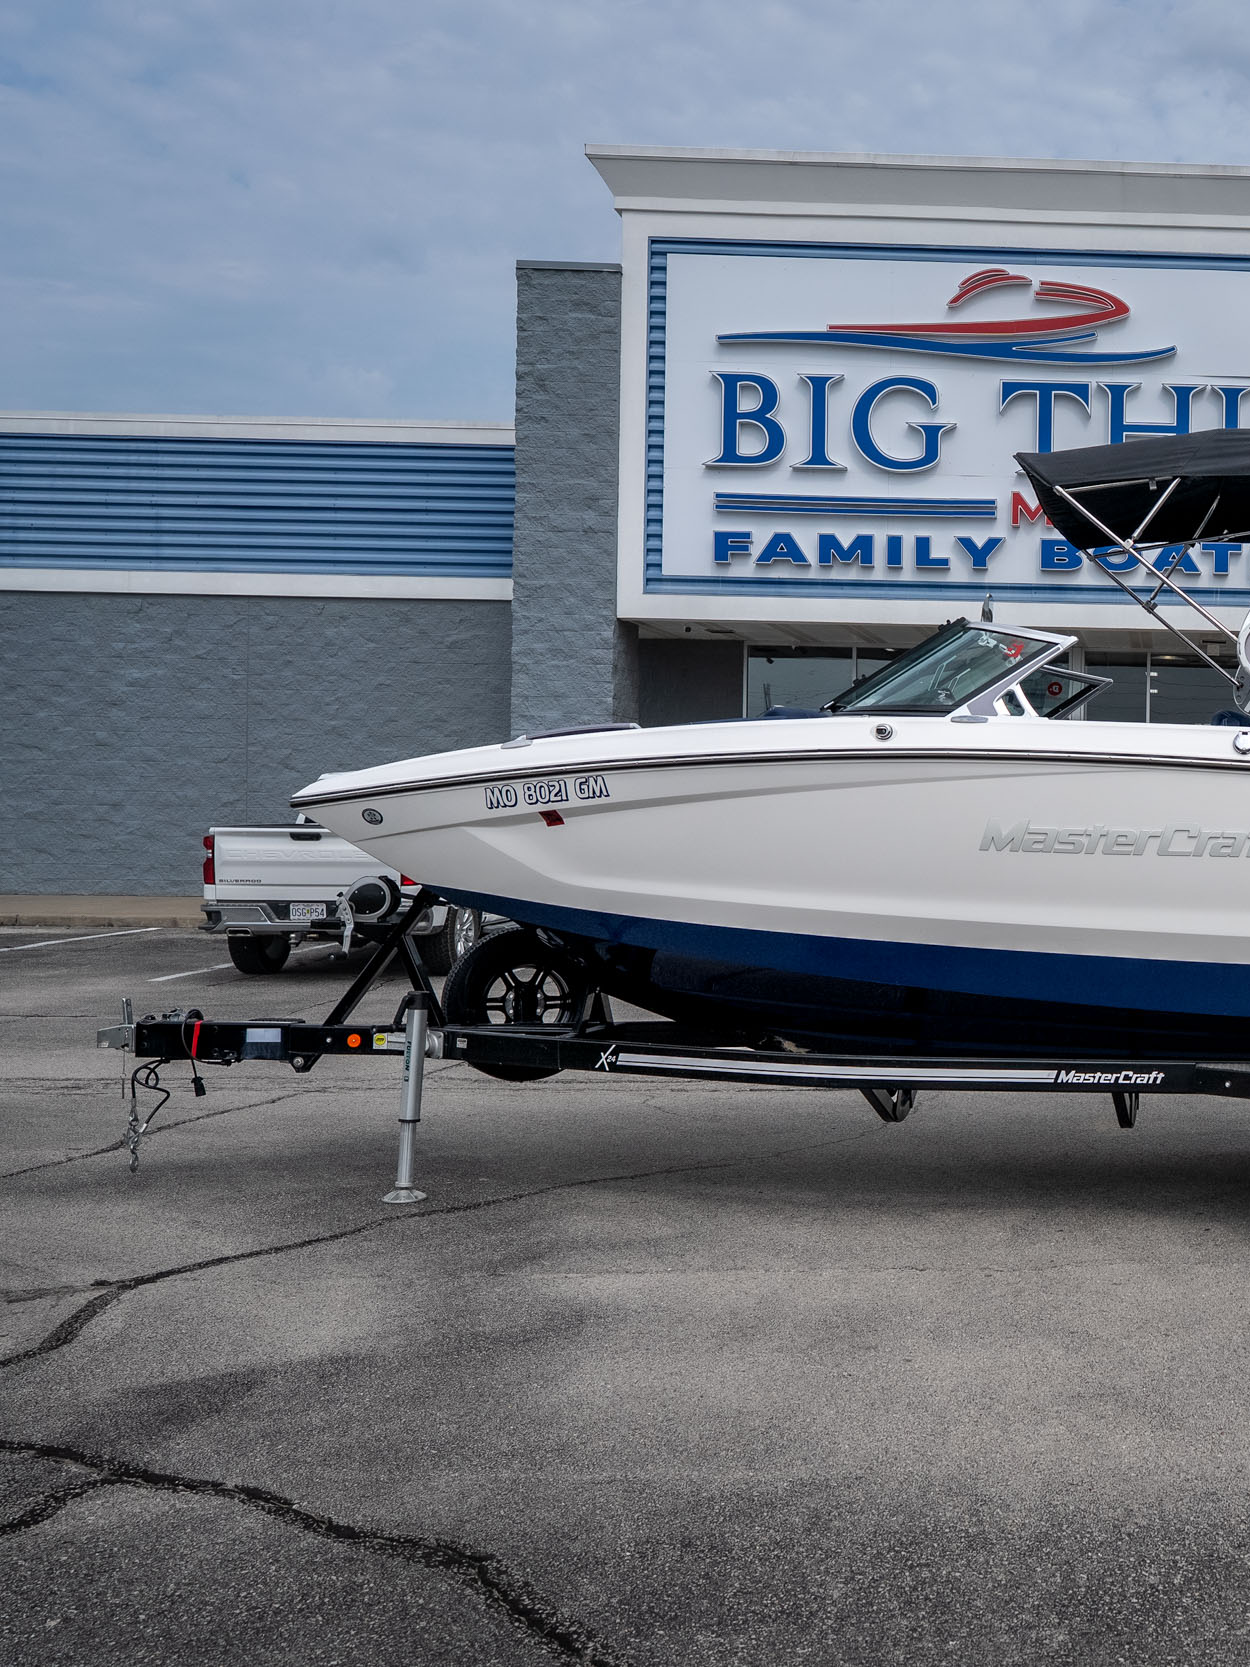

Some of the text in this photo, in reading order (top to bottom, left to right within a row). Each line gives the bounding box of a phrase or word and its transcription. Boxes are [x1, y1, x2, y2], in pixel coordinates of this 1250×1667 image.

[702, 371, 957, 473] BIG
[713, 530, 1006, 569] FAMILY
[485, 775, 610, 809] MO 8021 GM
[309, 907, 325, 917] P54
[1057, 1070, 1165, 1084] MasterCraft
